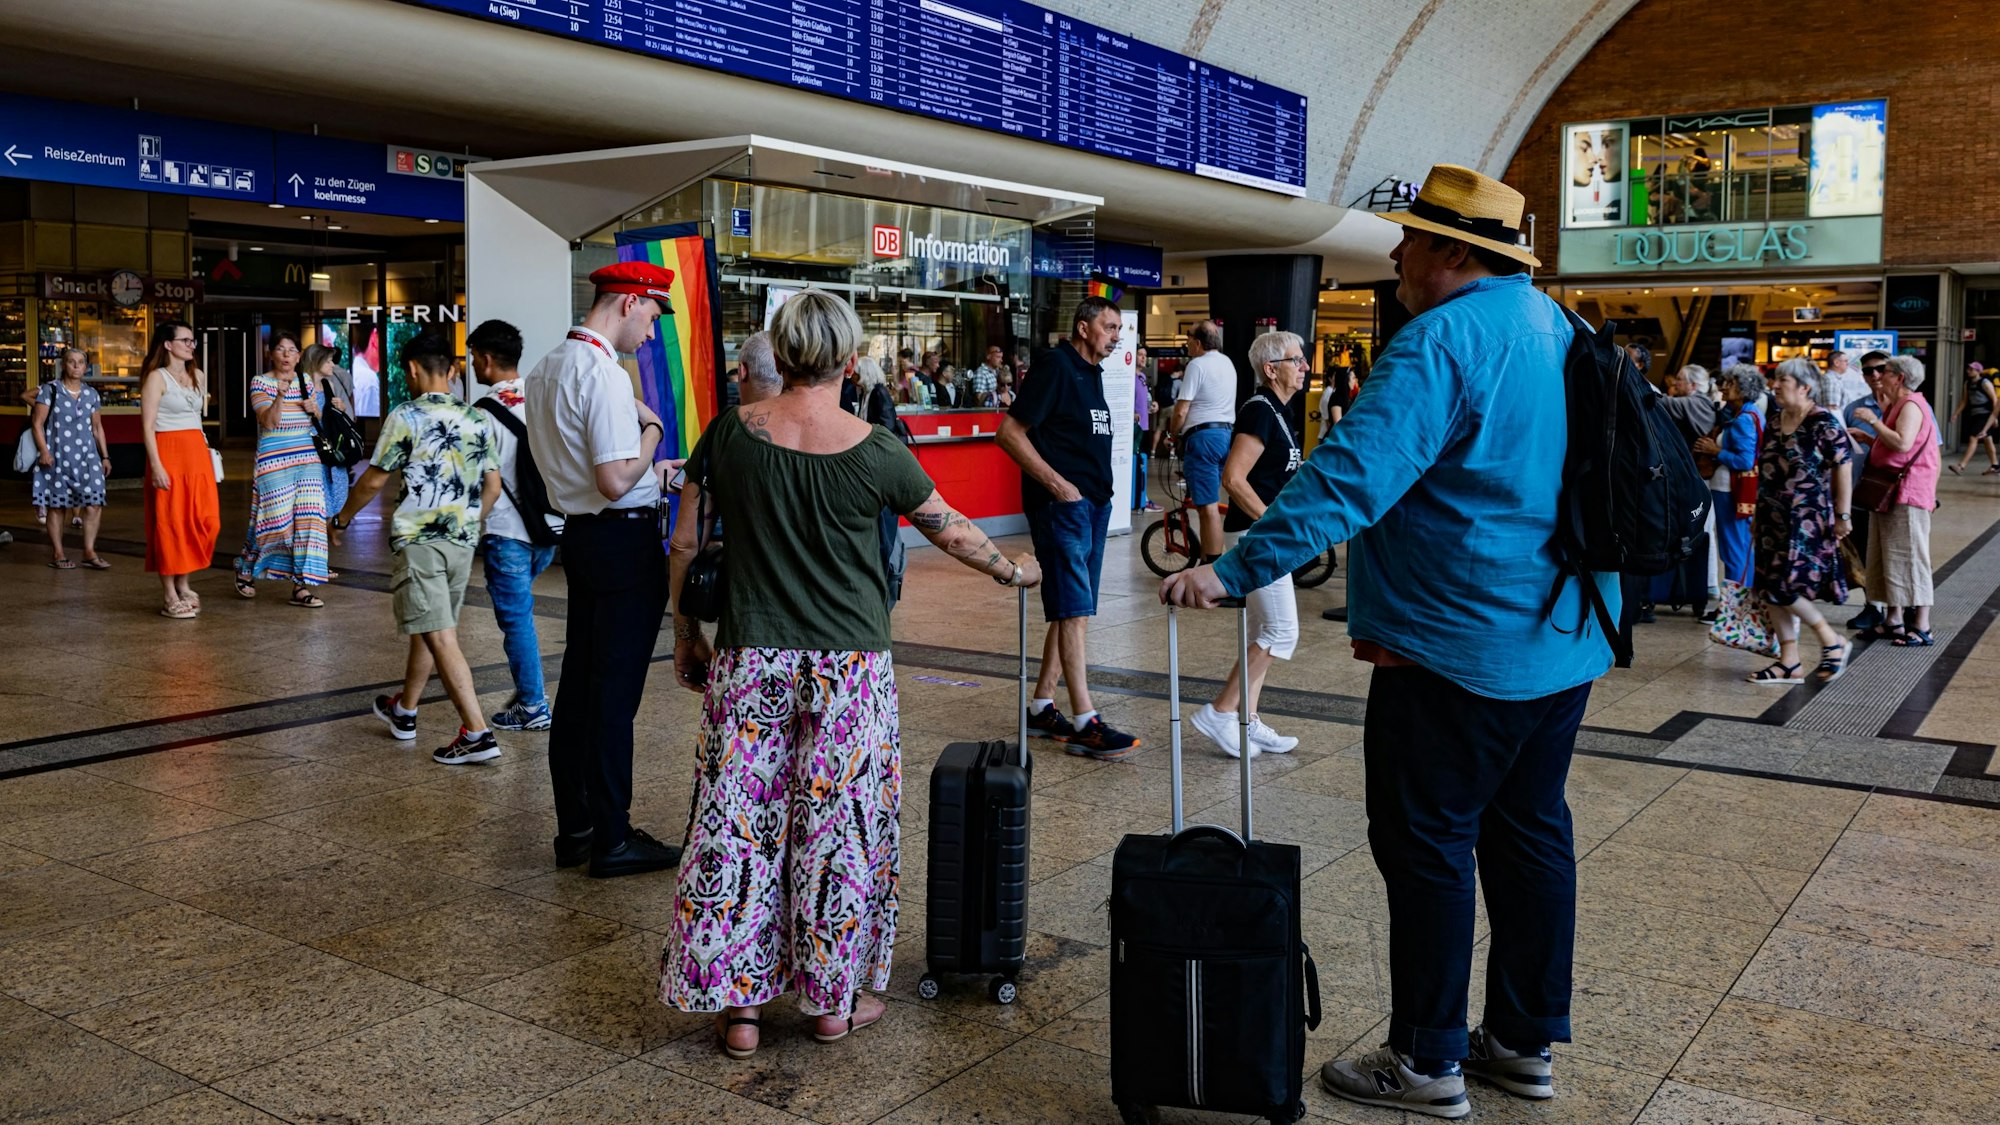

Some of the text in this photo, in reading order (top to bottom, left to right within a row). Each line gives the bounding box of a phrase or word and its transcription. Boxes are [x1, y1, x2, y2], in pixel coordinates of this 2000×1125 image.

[489, 3, 520, 20] Au (Sieg)
[570, 5, 578, 15] 11
[605, 13, 622, 25] 12:54
[570, 22, 579, 32] 10
[605, 29, 622, 41] 12:54
[44, 146, 126, 167] ReiseZentrum
[417, 154, 430, 174] S
[437, 162, 449, 171] Bus
[314, 177, 375, 192] zu den Zügen
[314, 189, 366, 204] koelnmesse
[876, 229, 1010, 266] DB Information
[1616, 224, 1809, 266] DOUGLAS
[52, 276, 195, 301] Snack Stop
[346, 304, 459, 324] ETERN
[1090, 409, 1109, 422] EHF
